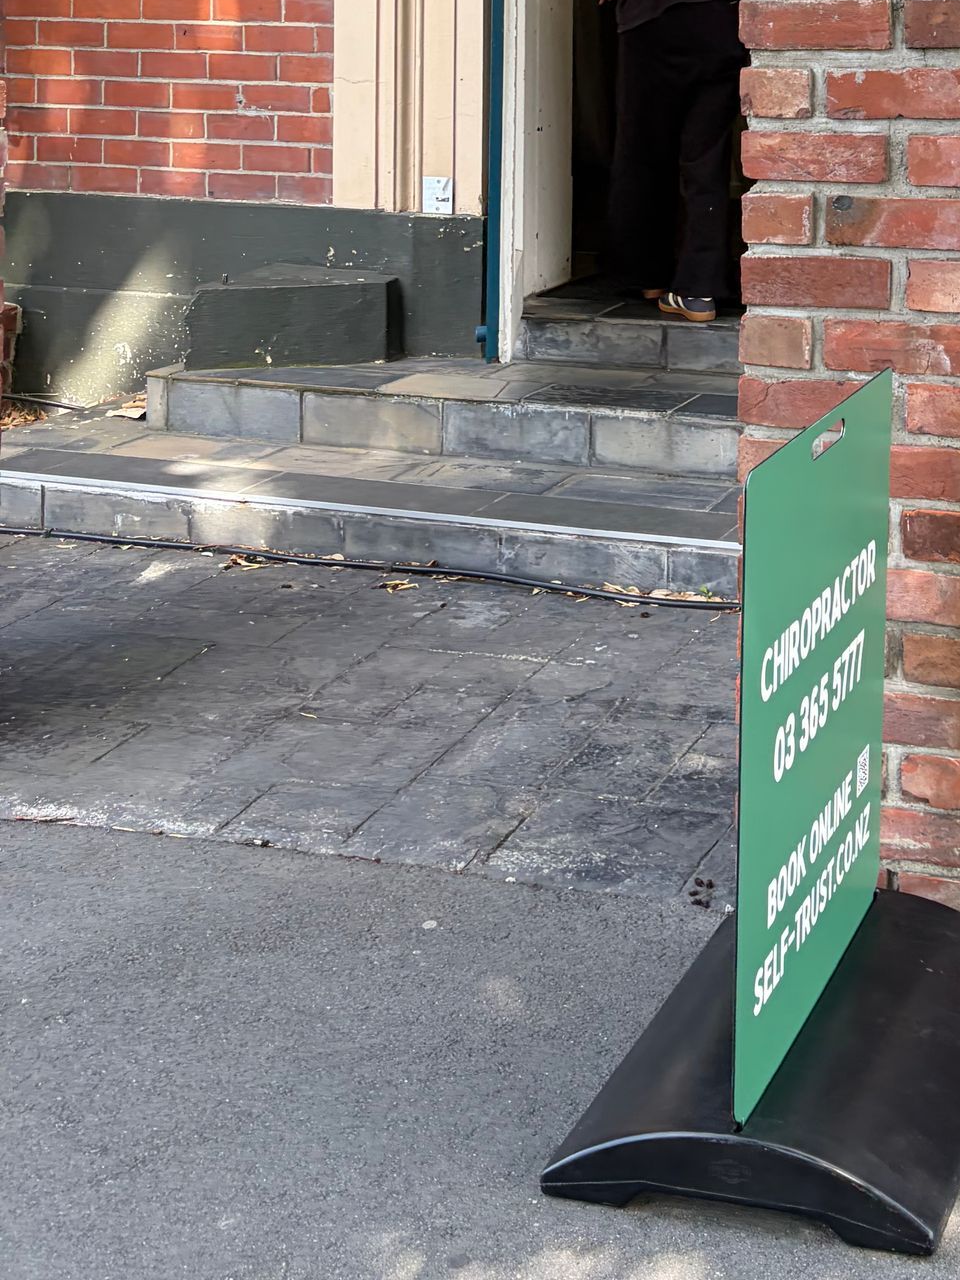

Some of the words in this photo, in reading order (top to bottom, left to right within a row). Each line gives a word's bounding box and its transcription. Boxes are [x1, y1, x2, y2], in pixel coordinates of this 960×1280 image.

[760, 539, 876, 702] CHIROPRACTOR
[773, 712, 796, 783] 03
[799, 672, 829, 752] 365
[832, 628, 864, 711] 5777
[753, 801, 871, 1017] SELF-TRUST.CO.NZ
[767, 835, 807, 929] BOOK
[809, 770, 853, 864] ONLINE
